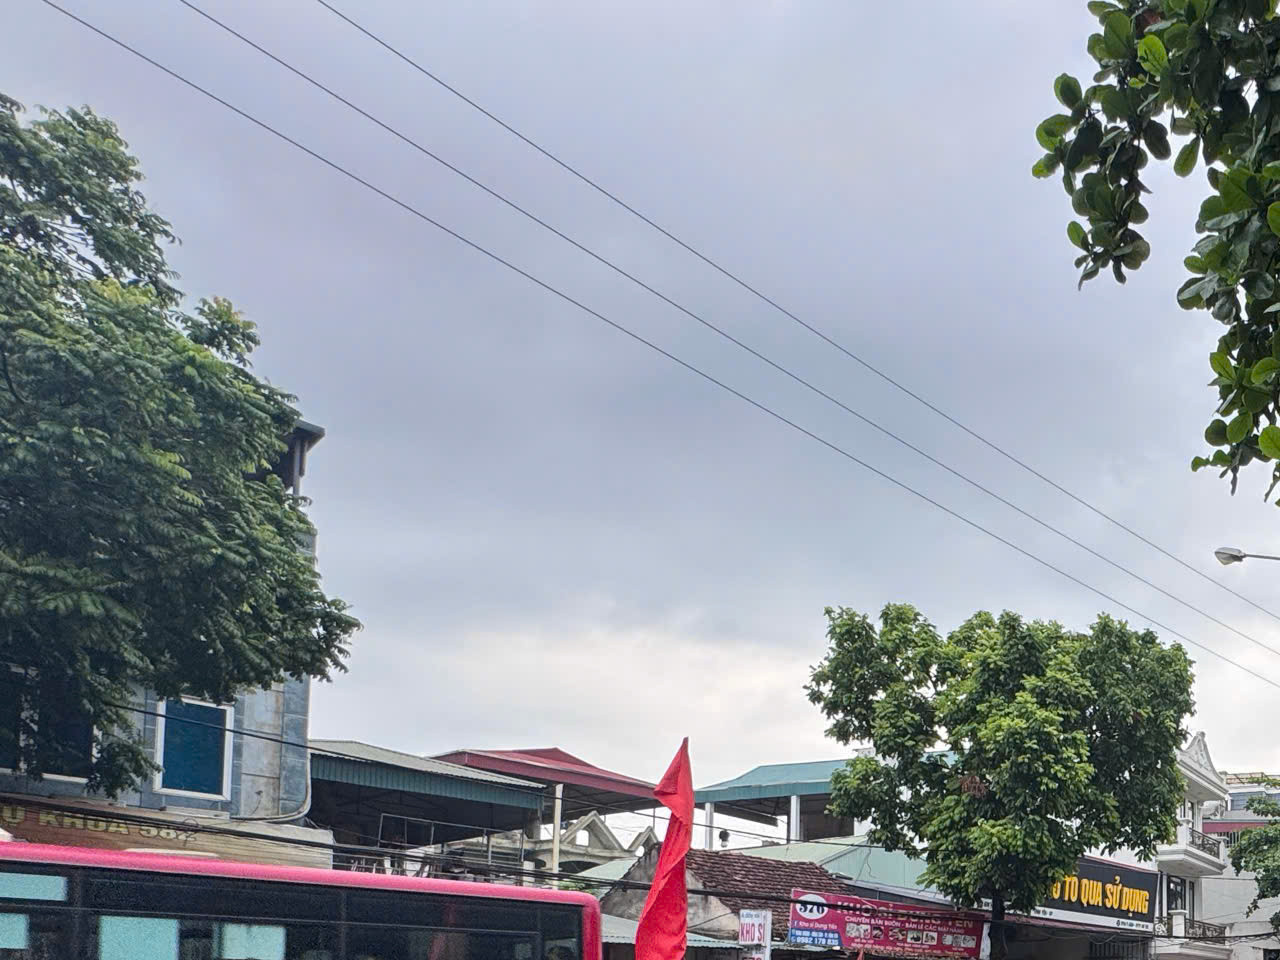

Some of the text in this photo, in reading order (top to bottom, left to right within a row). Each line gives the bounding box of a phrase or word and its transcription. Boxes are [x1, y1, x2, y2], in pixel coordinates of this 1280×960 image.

[1104, 875, 1122, 909] SỬ
[1121, 886, 1149, 917] DỤNG
[740, 922, 756, 942] KHO
